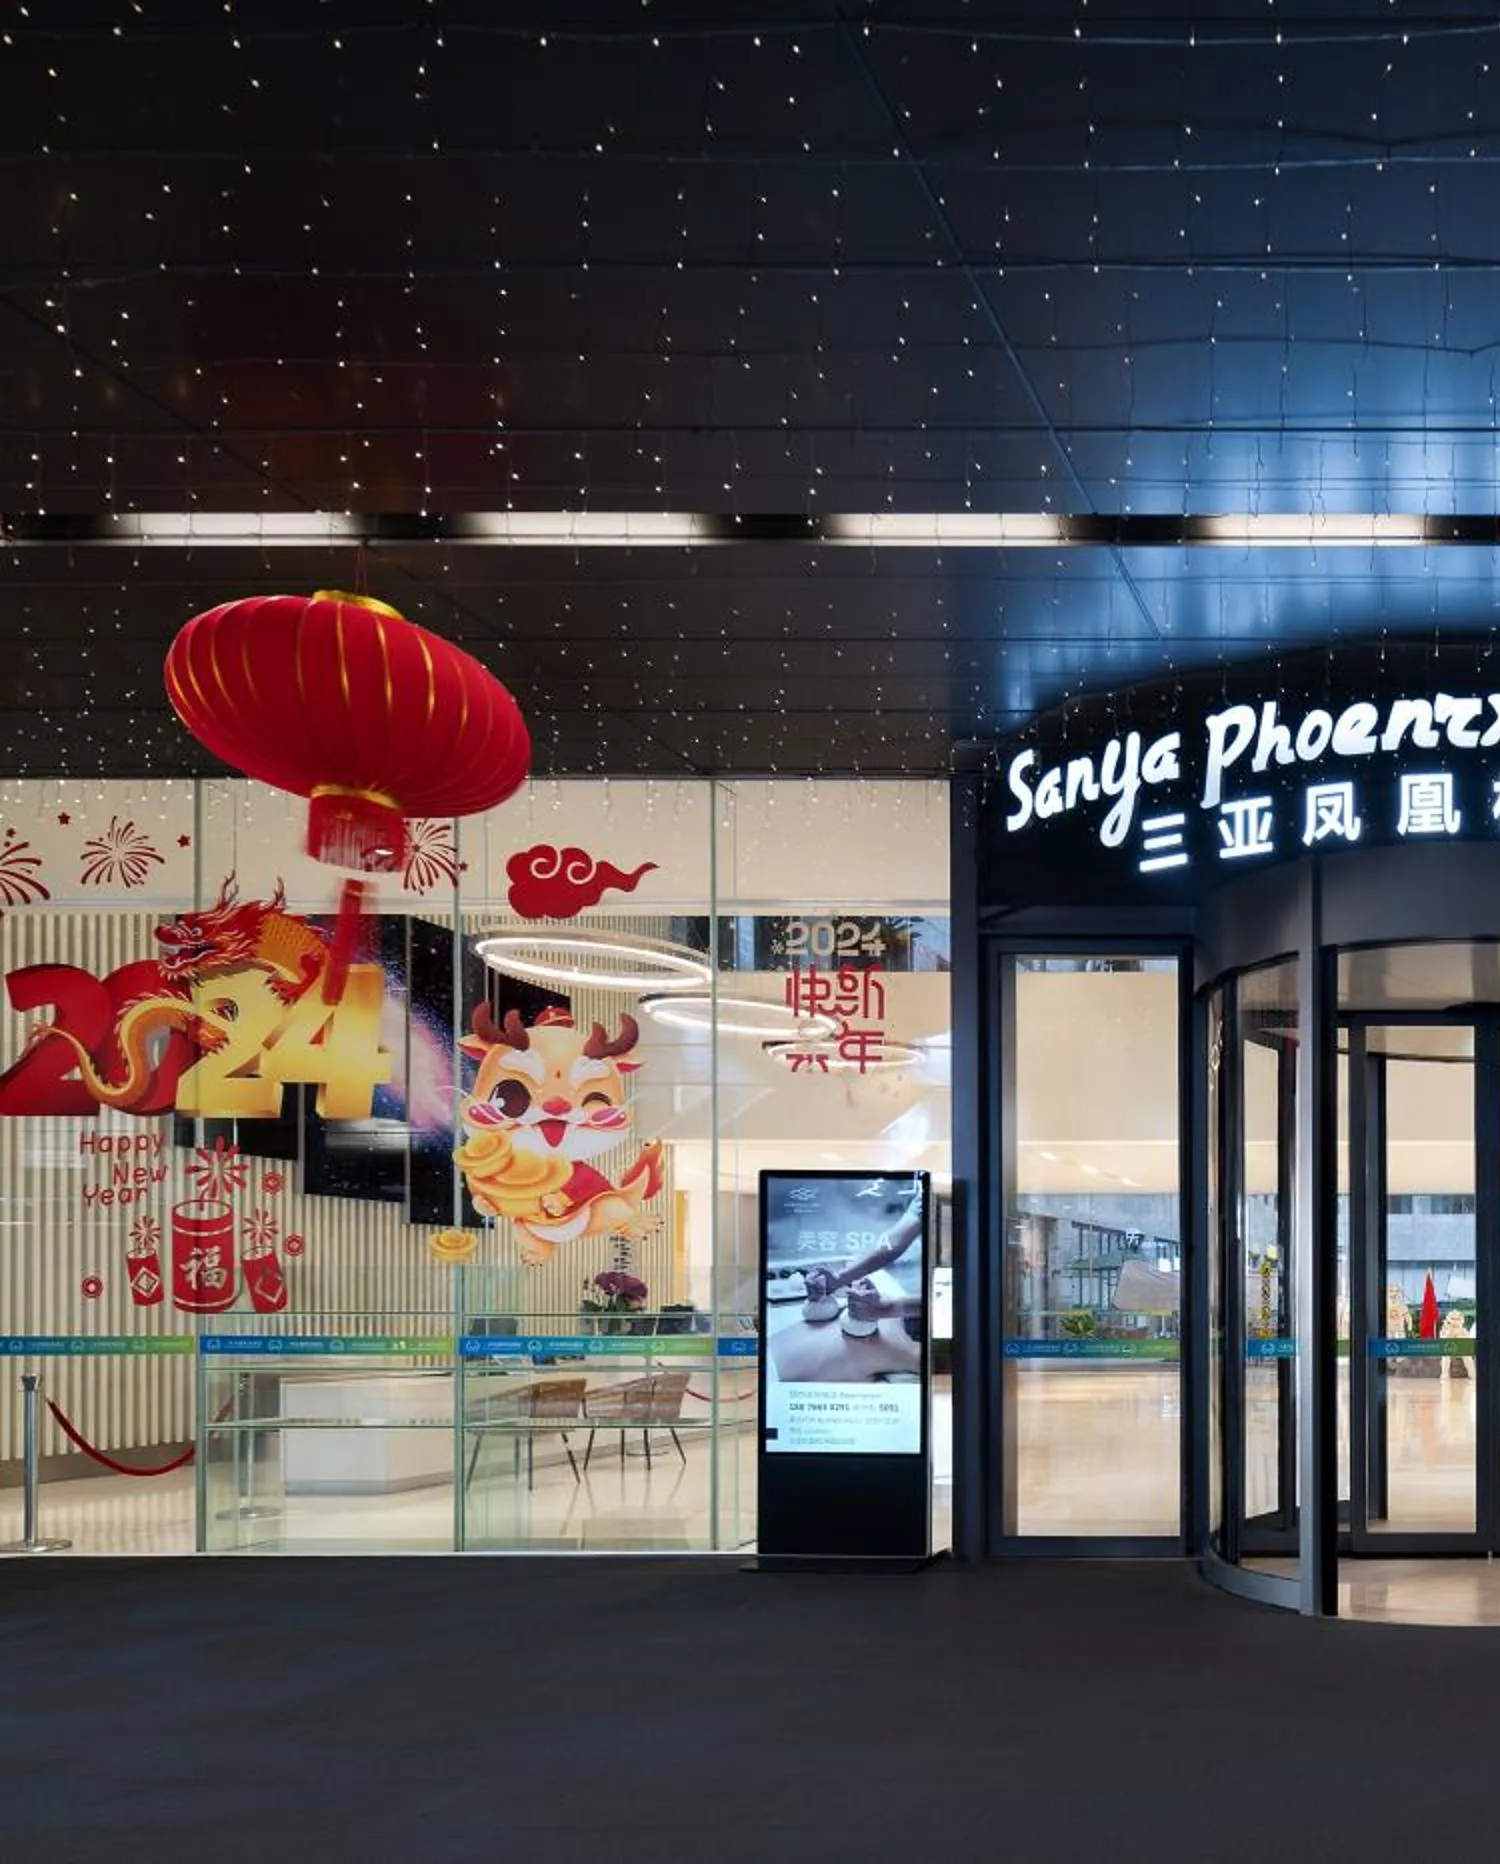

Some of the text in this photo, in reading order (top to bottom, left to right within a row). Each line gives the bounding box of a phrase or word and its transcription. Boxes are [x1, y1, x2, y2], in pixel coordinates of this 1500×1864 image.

[1006, 731, 1182, 848] Sanya
[784, 920, 887, 957] 2024
[80, 1131, 165, 1158] Happy
[113, 1162, 168, 1184] New
[82, 1183, 148, 1206] Year
[845, 1231, 893, 1250] SPA
[180, 1246, 229, 1291] 福
